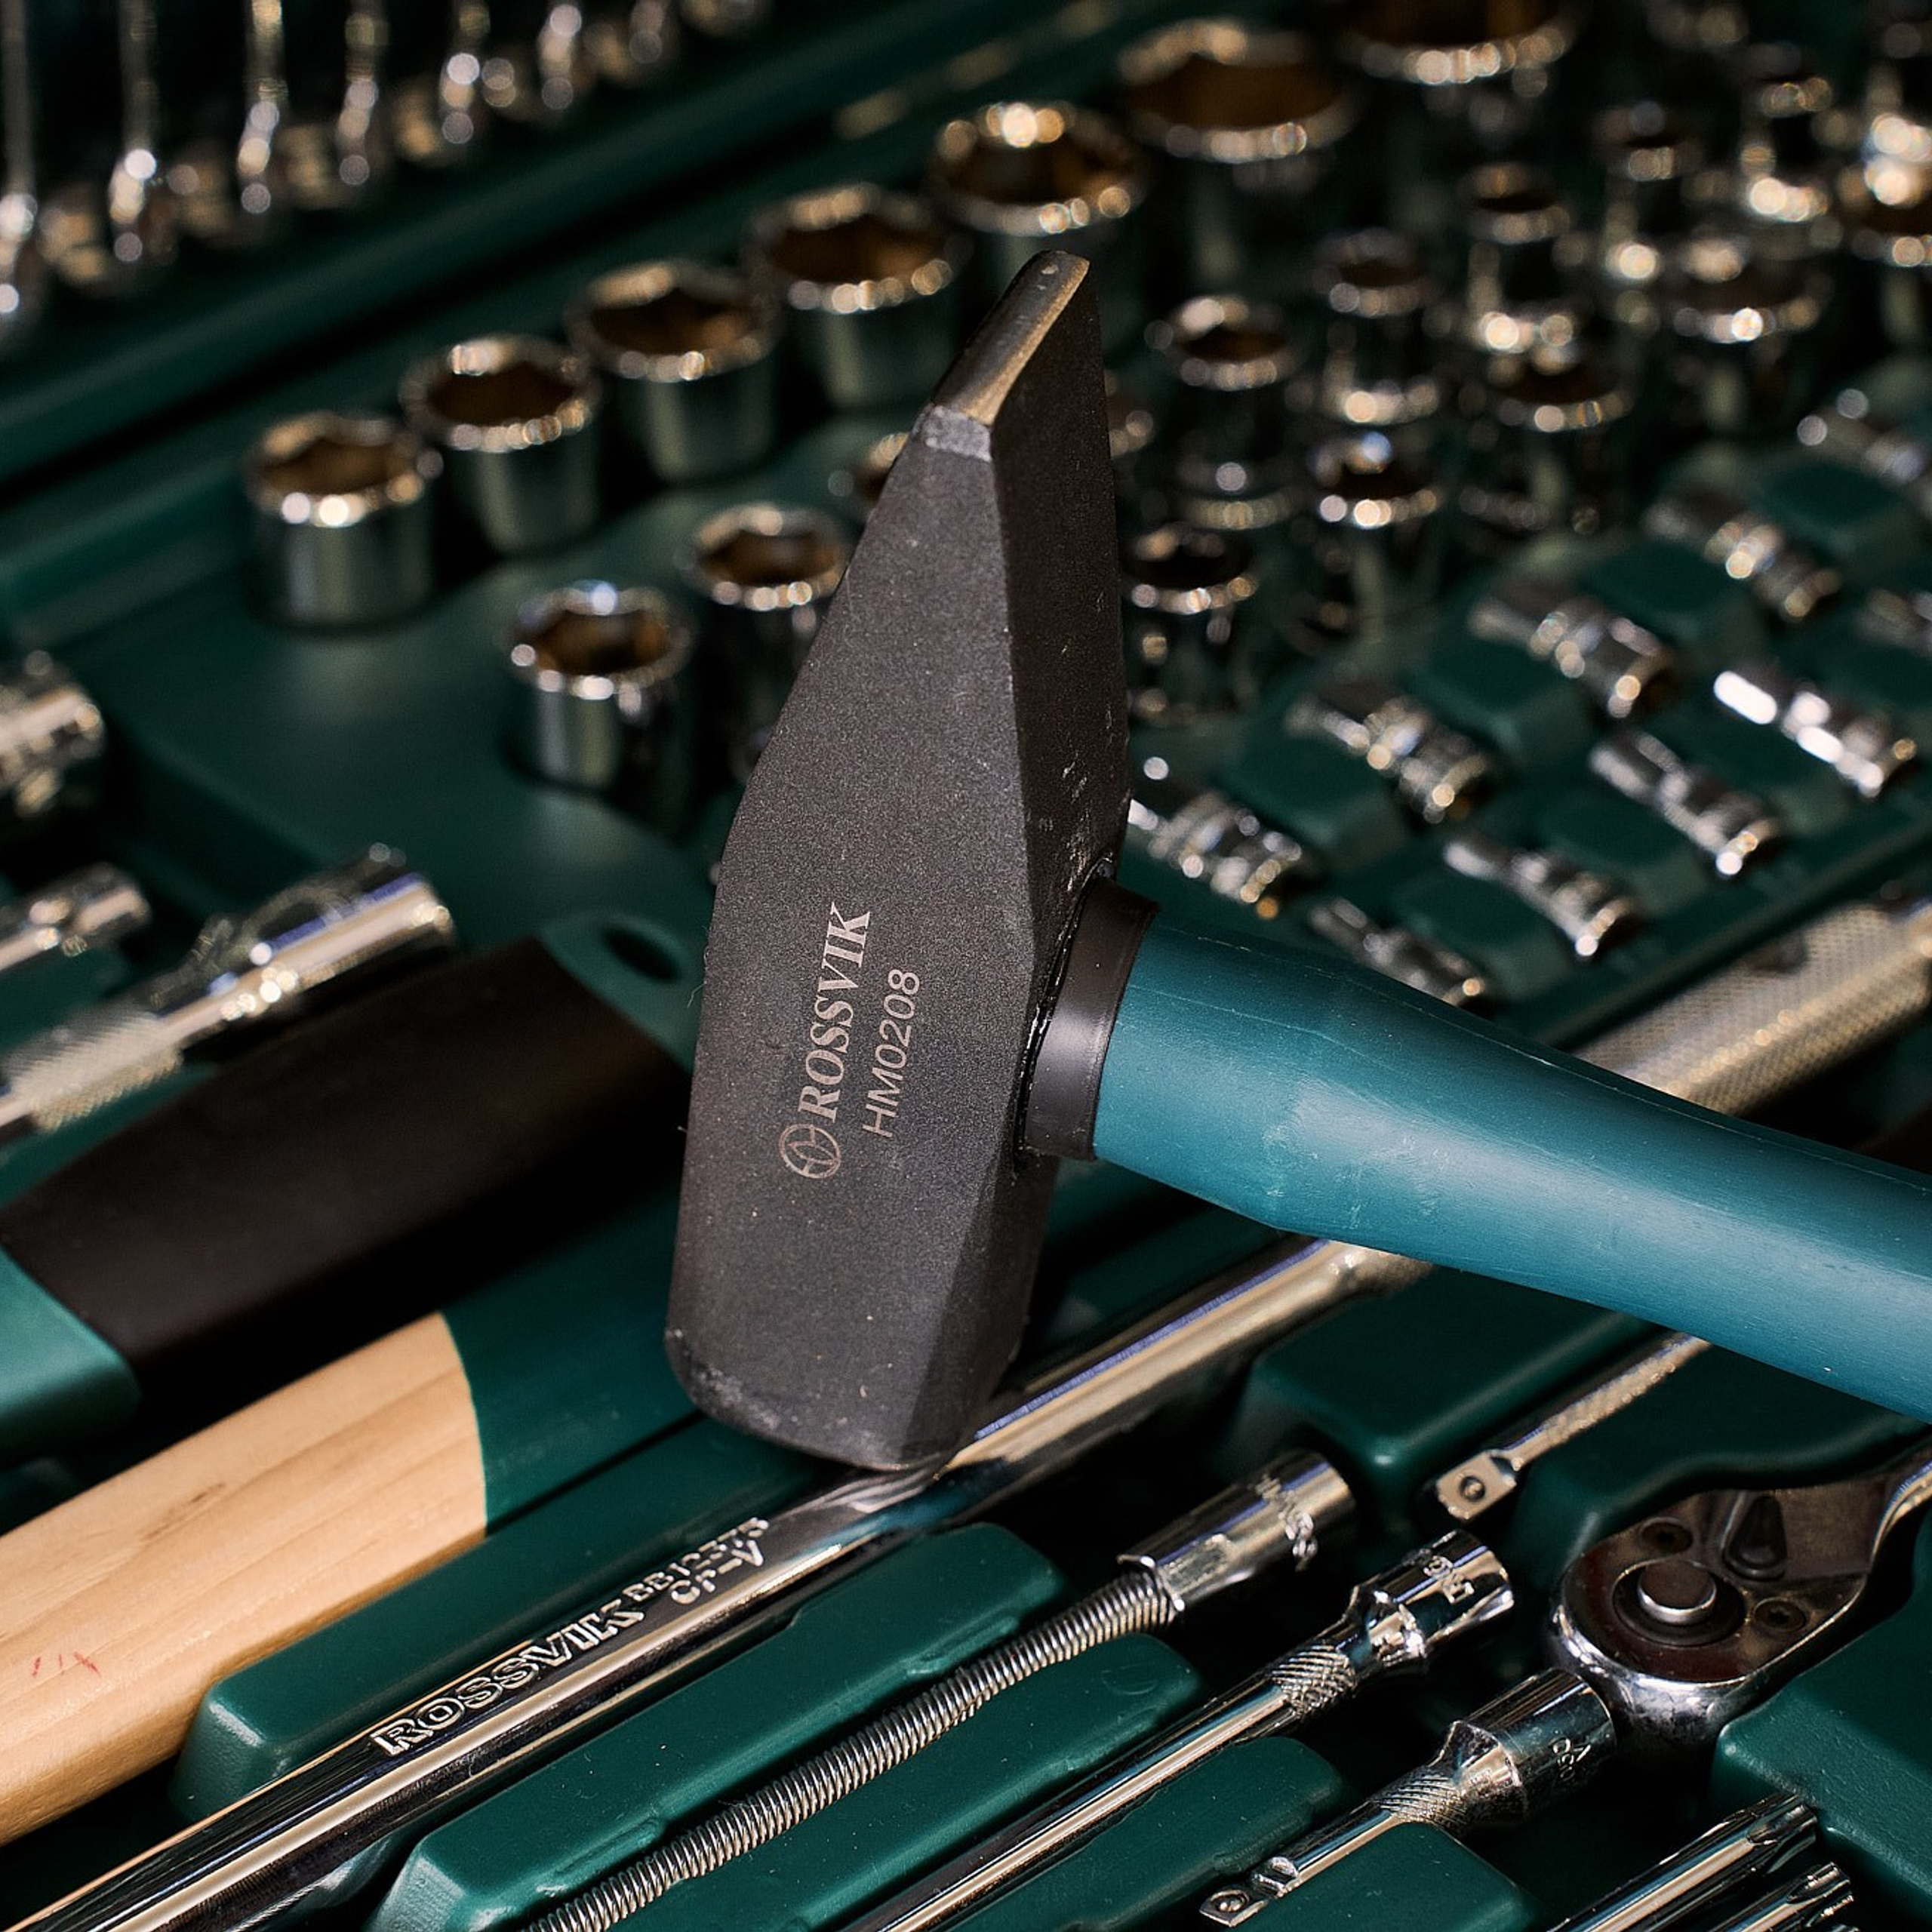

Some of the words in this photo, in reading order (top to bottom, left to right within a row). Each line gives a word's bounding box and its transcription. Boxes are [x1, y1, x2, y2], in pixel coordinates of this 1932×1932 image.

[798, 901, 871, 1124] ROSSVIK
[862, 968, 920, 1138] HM0208
[371, 1598, 645, 1757] ROSSVIK
